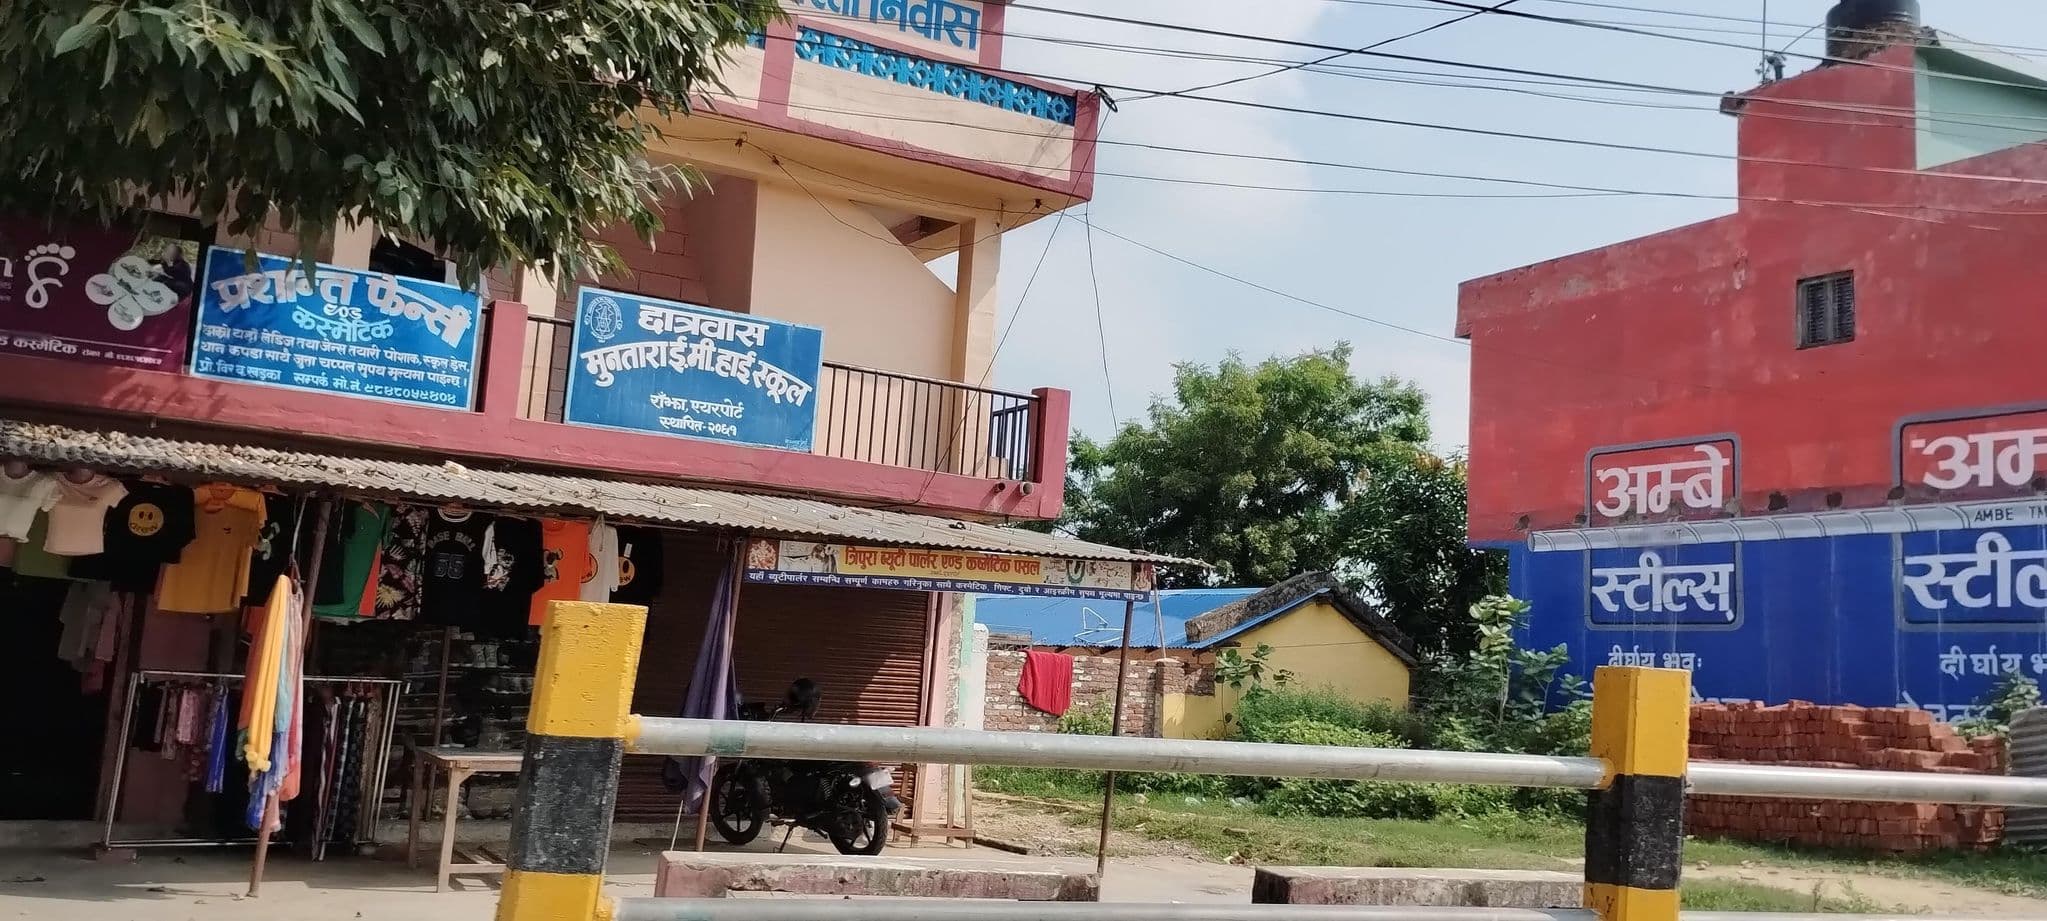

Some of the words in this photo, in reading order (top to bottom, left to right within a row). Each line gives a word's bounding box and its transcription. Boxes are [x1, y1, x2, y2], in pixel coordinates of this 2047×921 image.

[638, 304, 770, 347] छात्रवास
[293, 371, 329, 388] सम्पर्क
[752, 360, 813, 406] स्कूल
[690, 398, 745, 419] एयरपोर्ट
[1595, 444, 1731, 518] अम्बे
[1974, 507, 2015, 523] AMBE
[844, 546, 879, 570] त्रिपुरा
[908, 550, 940, 570] पार्लर
[941, 554, 964, 571] एण्ड
[1014, 559, 1040, 577] पसल
